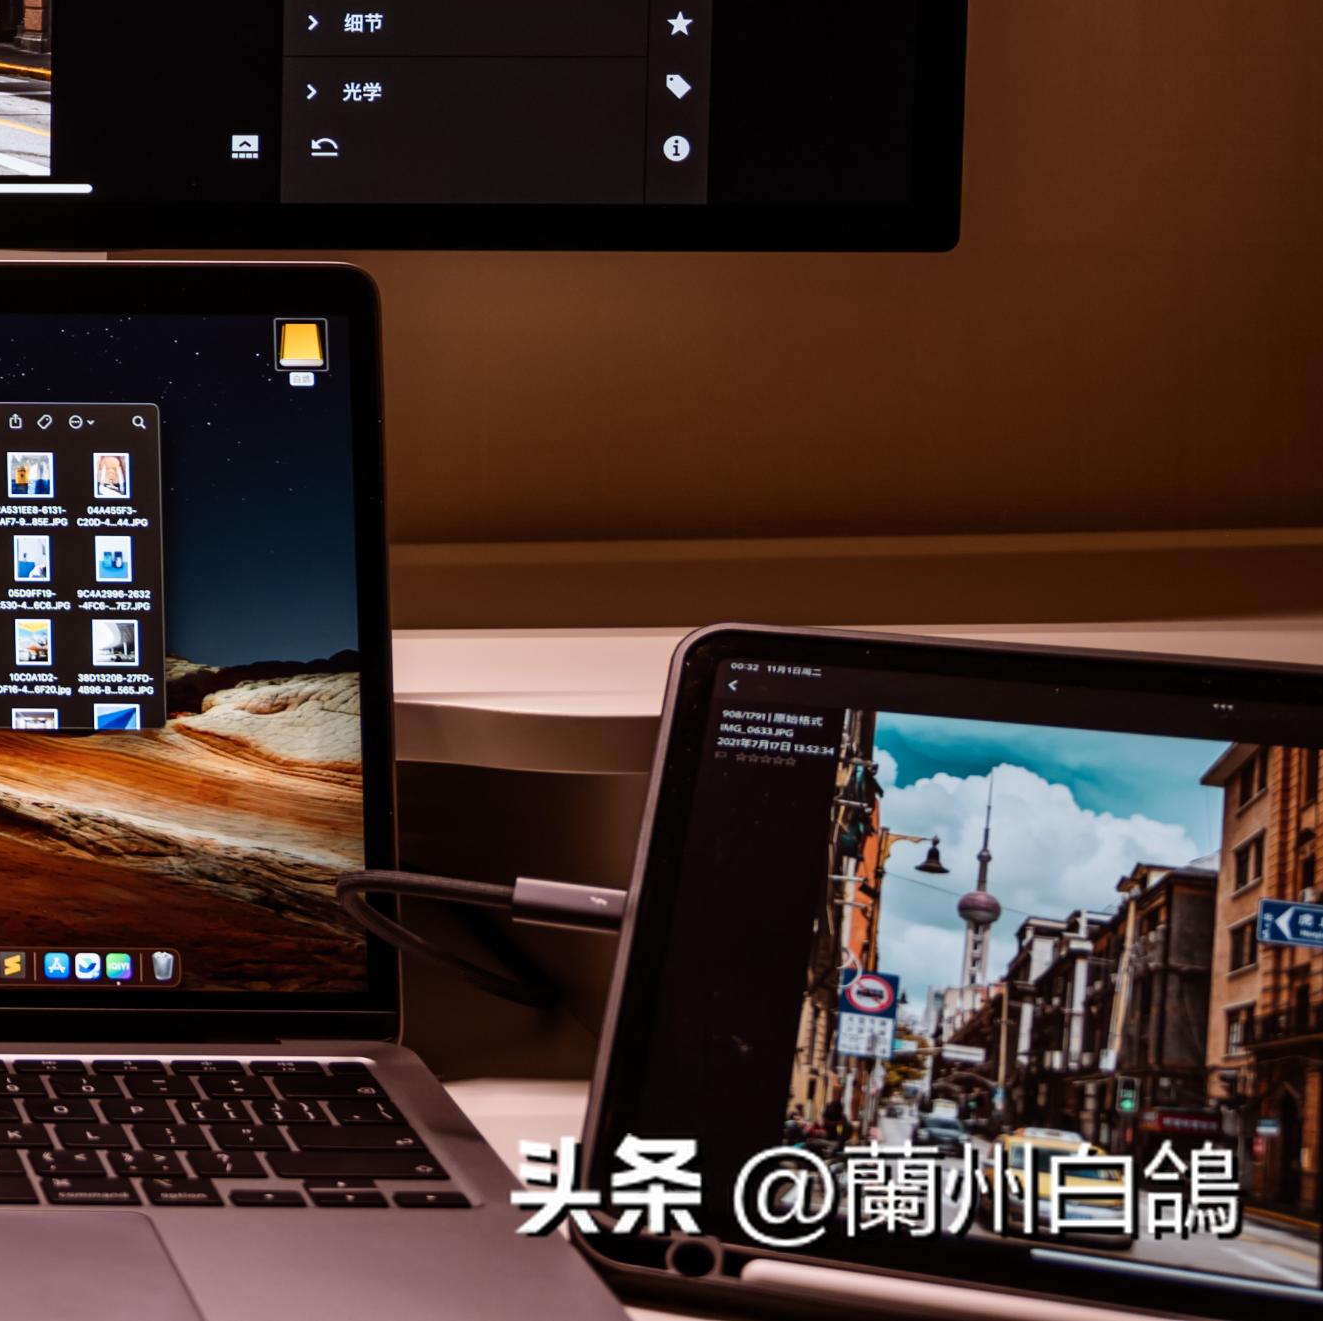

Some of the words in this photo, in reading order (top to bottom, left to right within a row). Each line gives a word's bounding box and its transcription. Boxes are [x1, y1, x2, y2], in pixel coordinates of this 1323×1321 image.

[344, 13, 383, 33] 细节
[342, 82, 382, 102] 光学
[731, 662, 759, 671] 00:32
